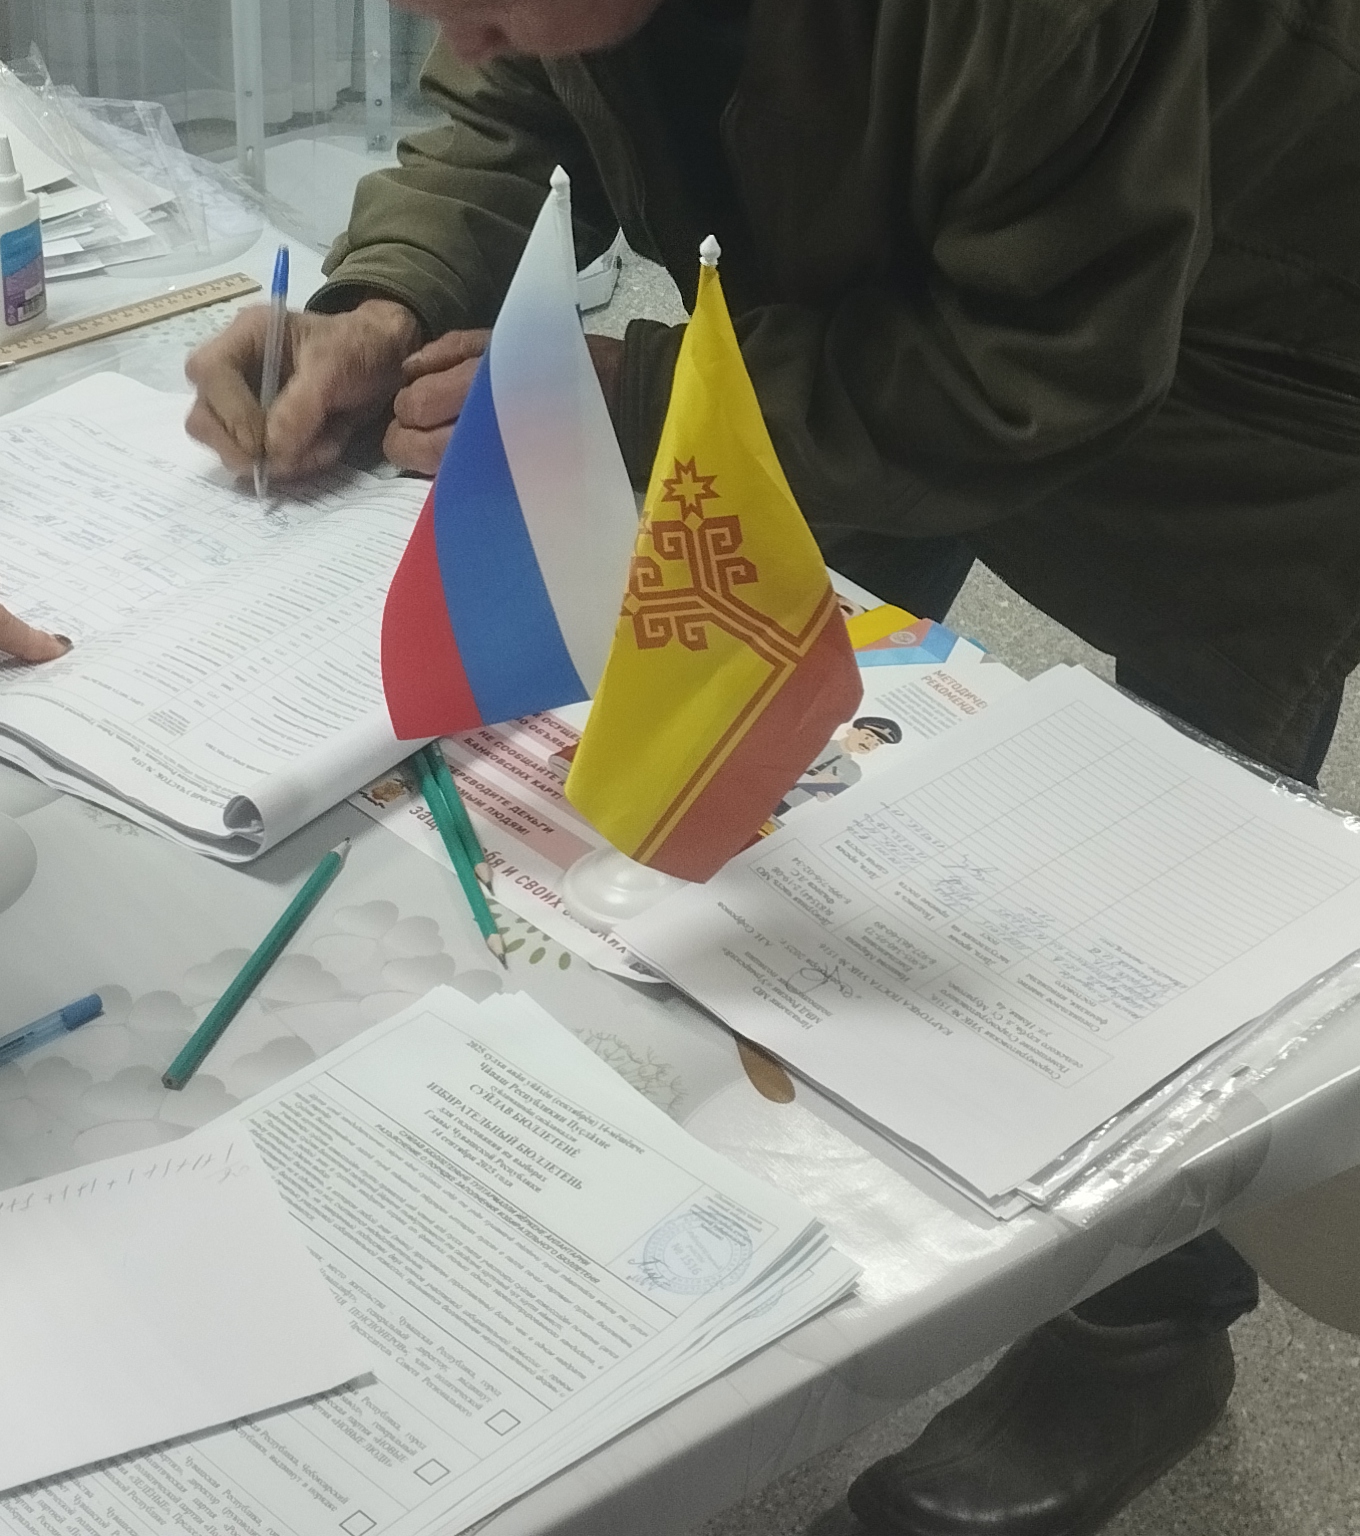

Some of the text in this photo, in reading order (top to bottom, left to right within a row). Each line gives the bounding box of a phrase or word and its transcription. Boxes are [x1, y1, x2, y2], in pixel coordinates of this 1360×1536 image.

[462, 735, 563, 802] БАНКОВСКИХ КАРТ!
[477, 728, 559, 783] НЕ СООБЩАЙТЕ
[483, 804, 530, 837] ЛЮДЯМ!
[507, 802, 555, 836] ДЕНЬГИ
[423, 1080, 588, 1191] ИЗБИРАТЕЛЬНЫЙ БЮЛЛЕТЕНЬ
